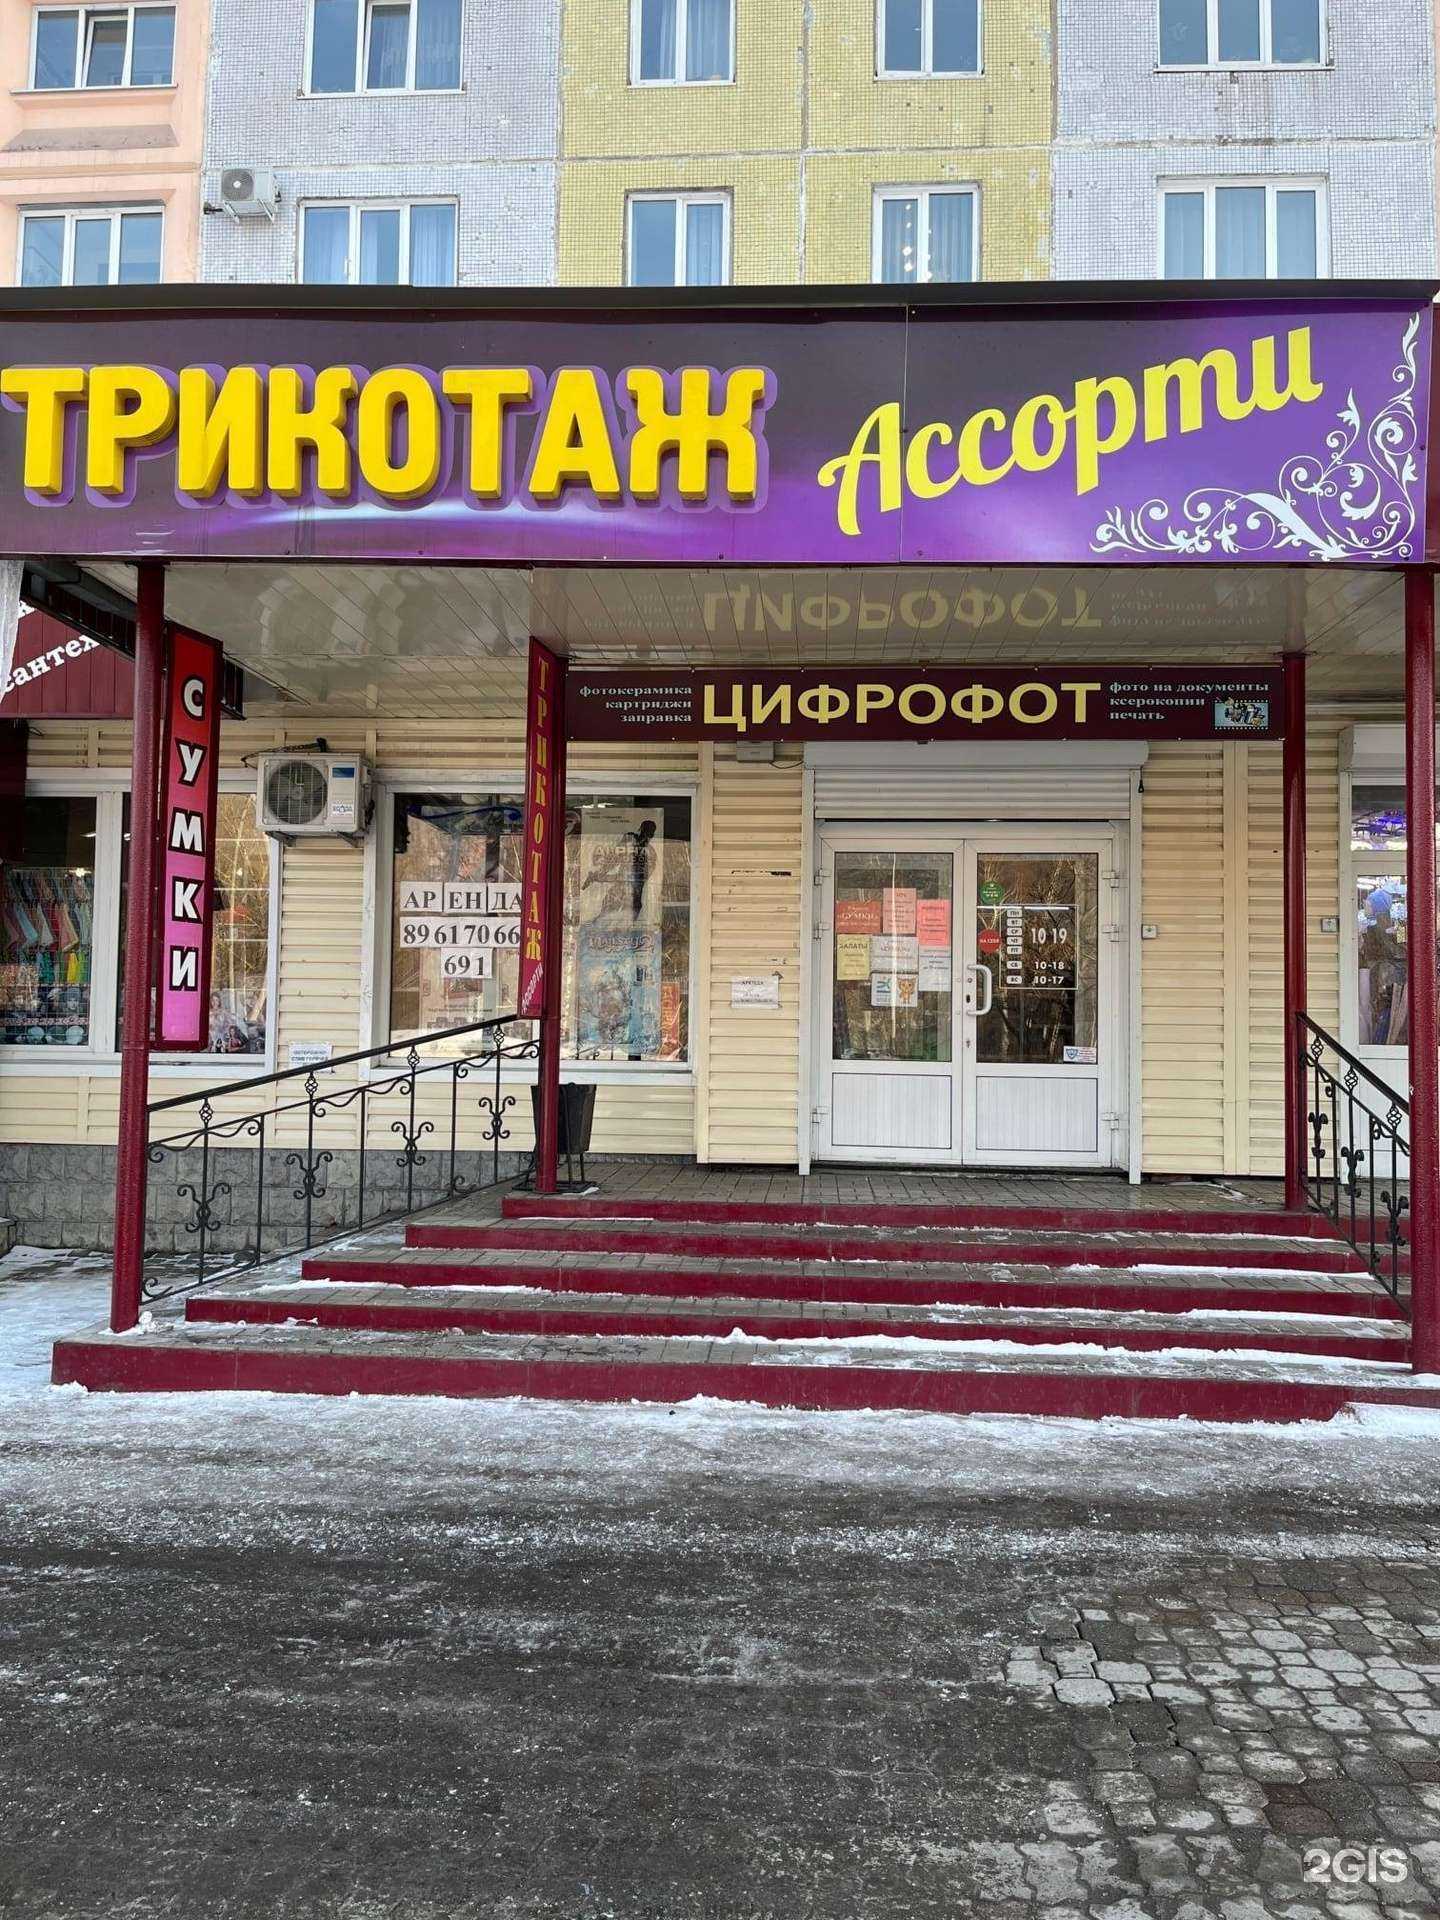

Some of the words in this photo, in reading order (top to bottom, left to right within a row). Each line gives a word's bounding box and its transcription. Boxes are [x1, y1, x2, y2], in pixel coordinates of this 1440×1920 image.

[0, 366, 766, 501] ТРИКОТАЖ
[817, 326, 1323, 536] Ассорти
[579, 685, 692, 697] фотокерамика
[1109, 682, 1149, 694] фото
[1153, 684, 1173, 692] на
[1176, 683, 1269, 694] документы
[605, 700, 692, 709] картриджи
[703, 683, 1101, 732] ЦИФРОФОТ
[1109, 697, 1205, 708] ксерокопии
[620, 713, 692, 724] заправка
[1109, 711, 1165, 721] печать
[526, 656, 549, 961] ТРИКОТАЖ
[171, 678, 204, 988] СУМКИ
[444, 954, 485, 976] 691
[1034, 961, 1065, 970] 10-18
